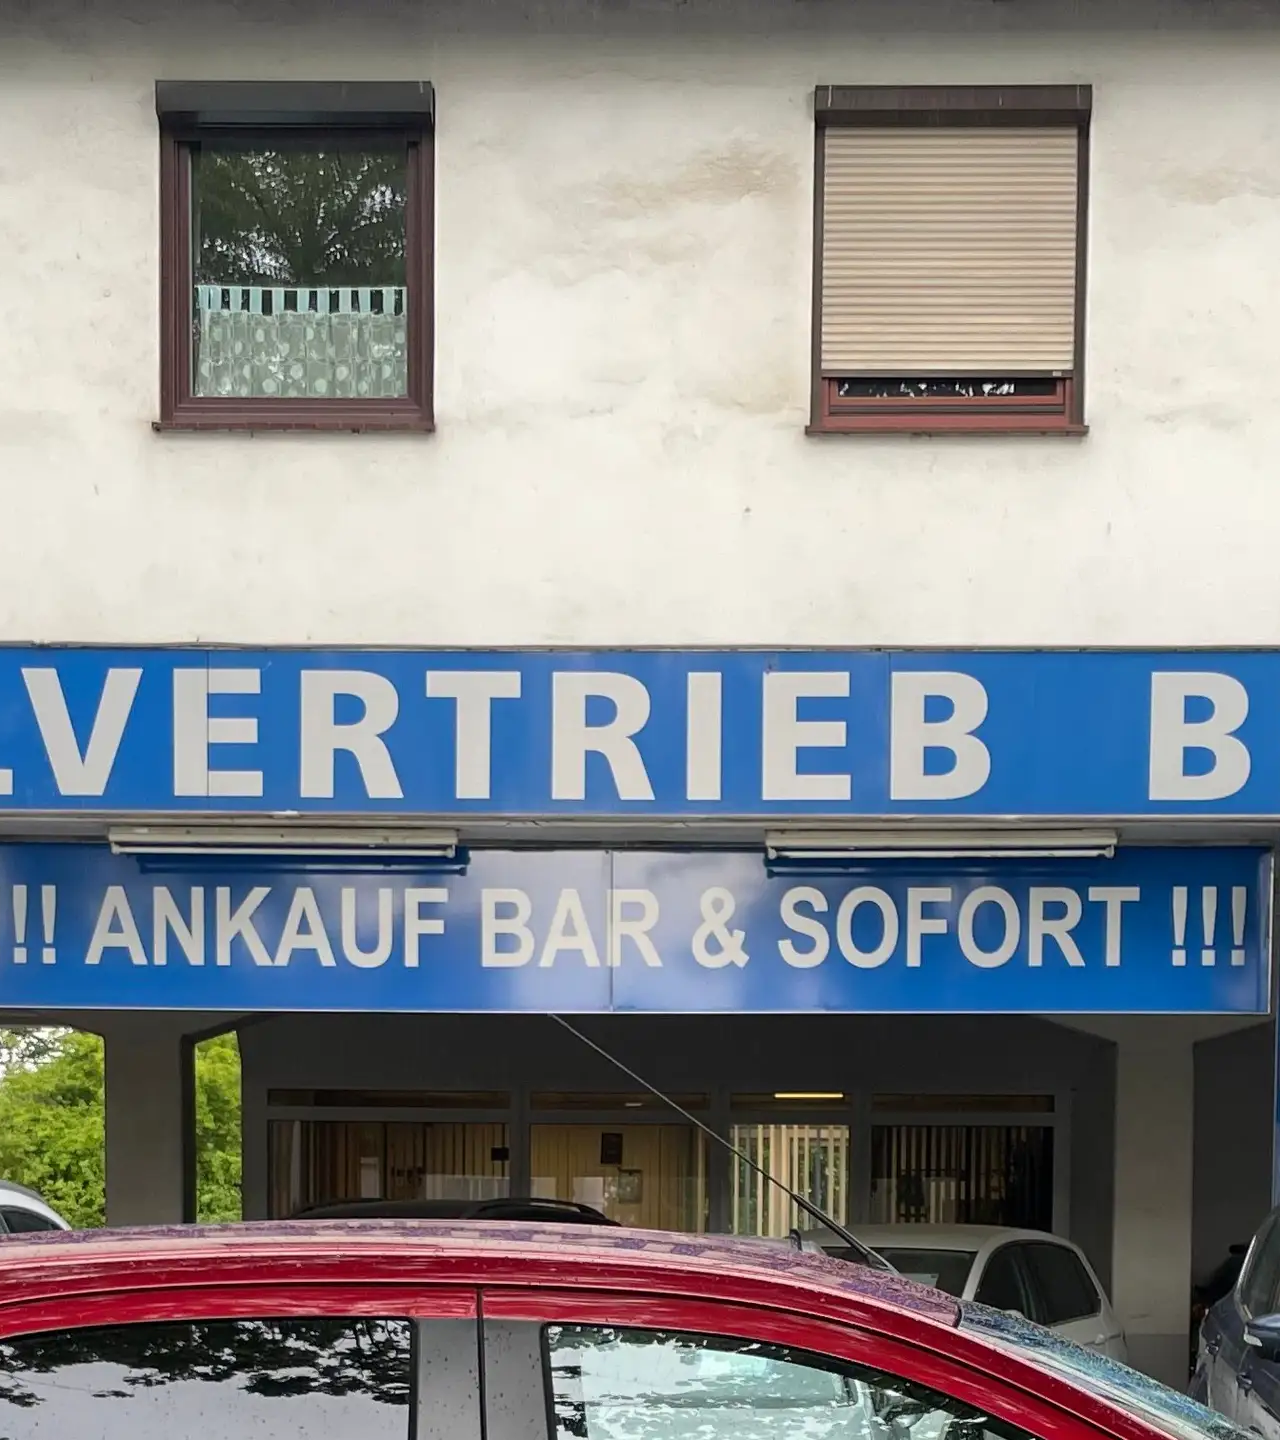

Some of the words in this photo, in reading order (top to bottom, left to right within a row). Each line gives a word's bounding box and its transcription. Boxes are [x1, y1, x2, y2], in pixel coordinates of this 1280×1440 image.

[85, 885, 449, 969] ANKAUF
[481, 887, 661, 969] BAR
[691, 886, 750, 970] &
[778, 886, 1141, 970] SOFORT
[1170, 885, 1248, 967] !!!
